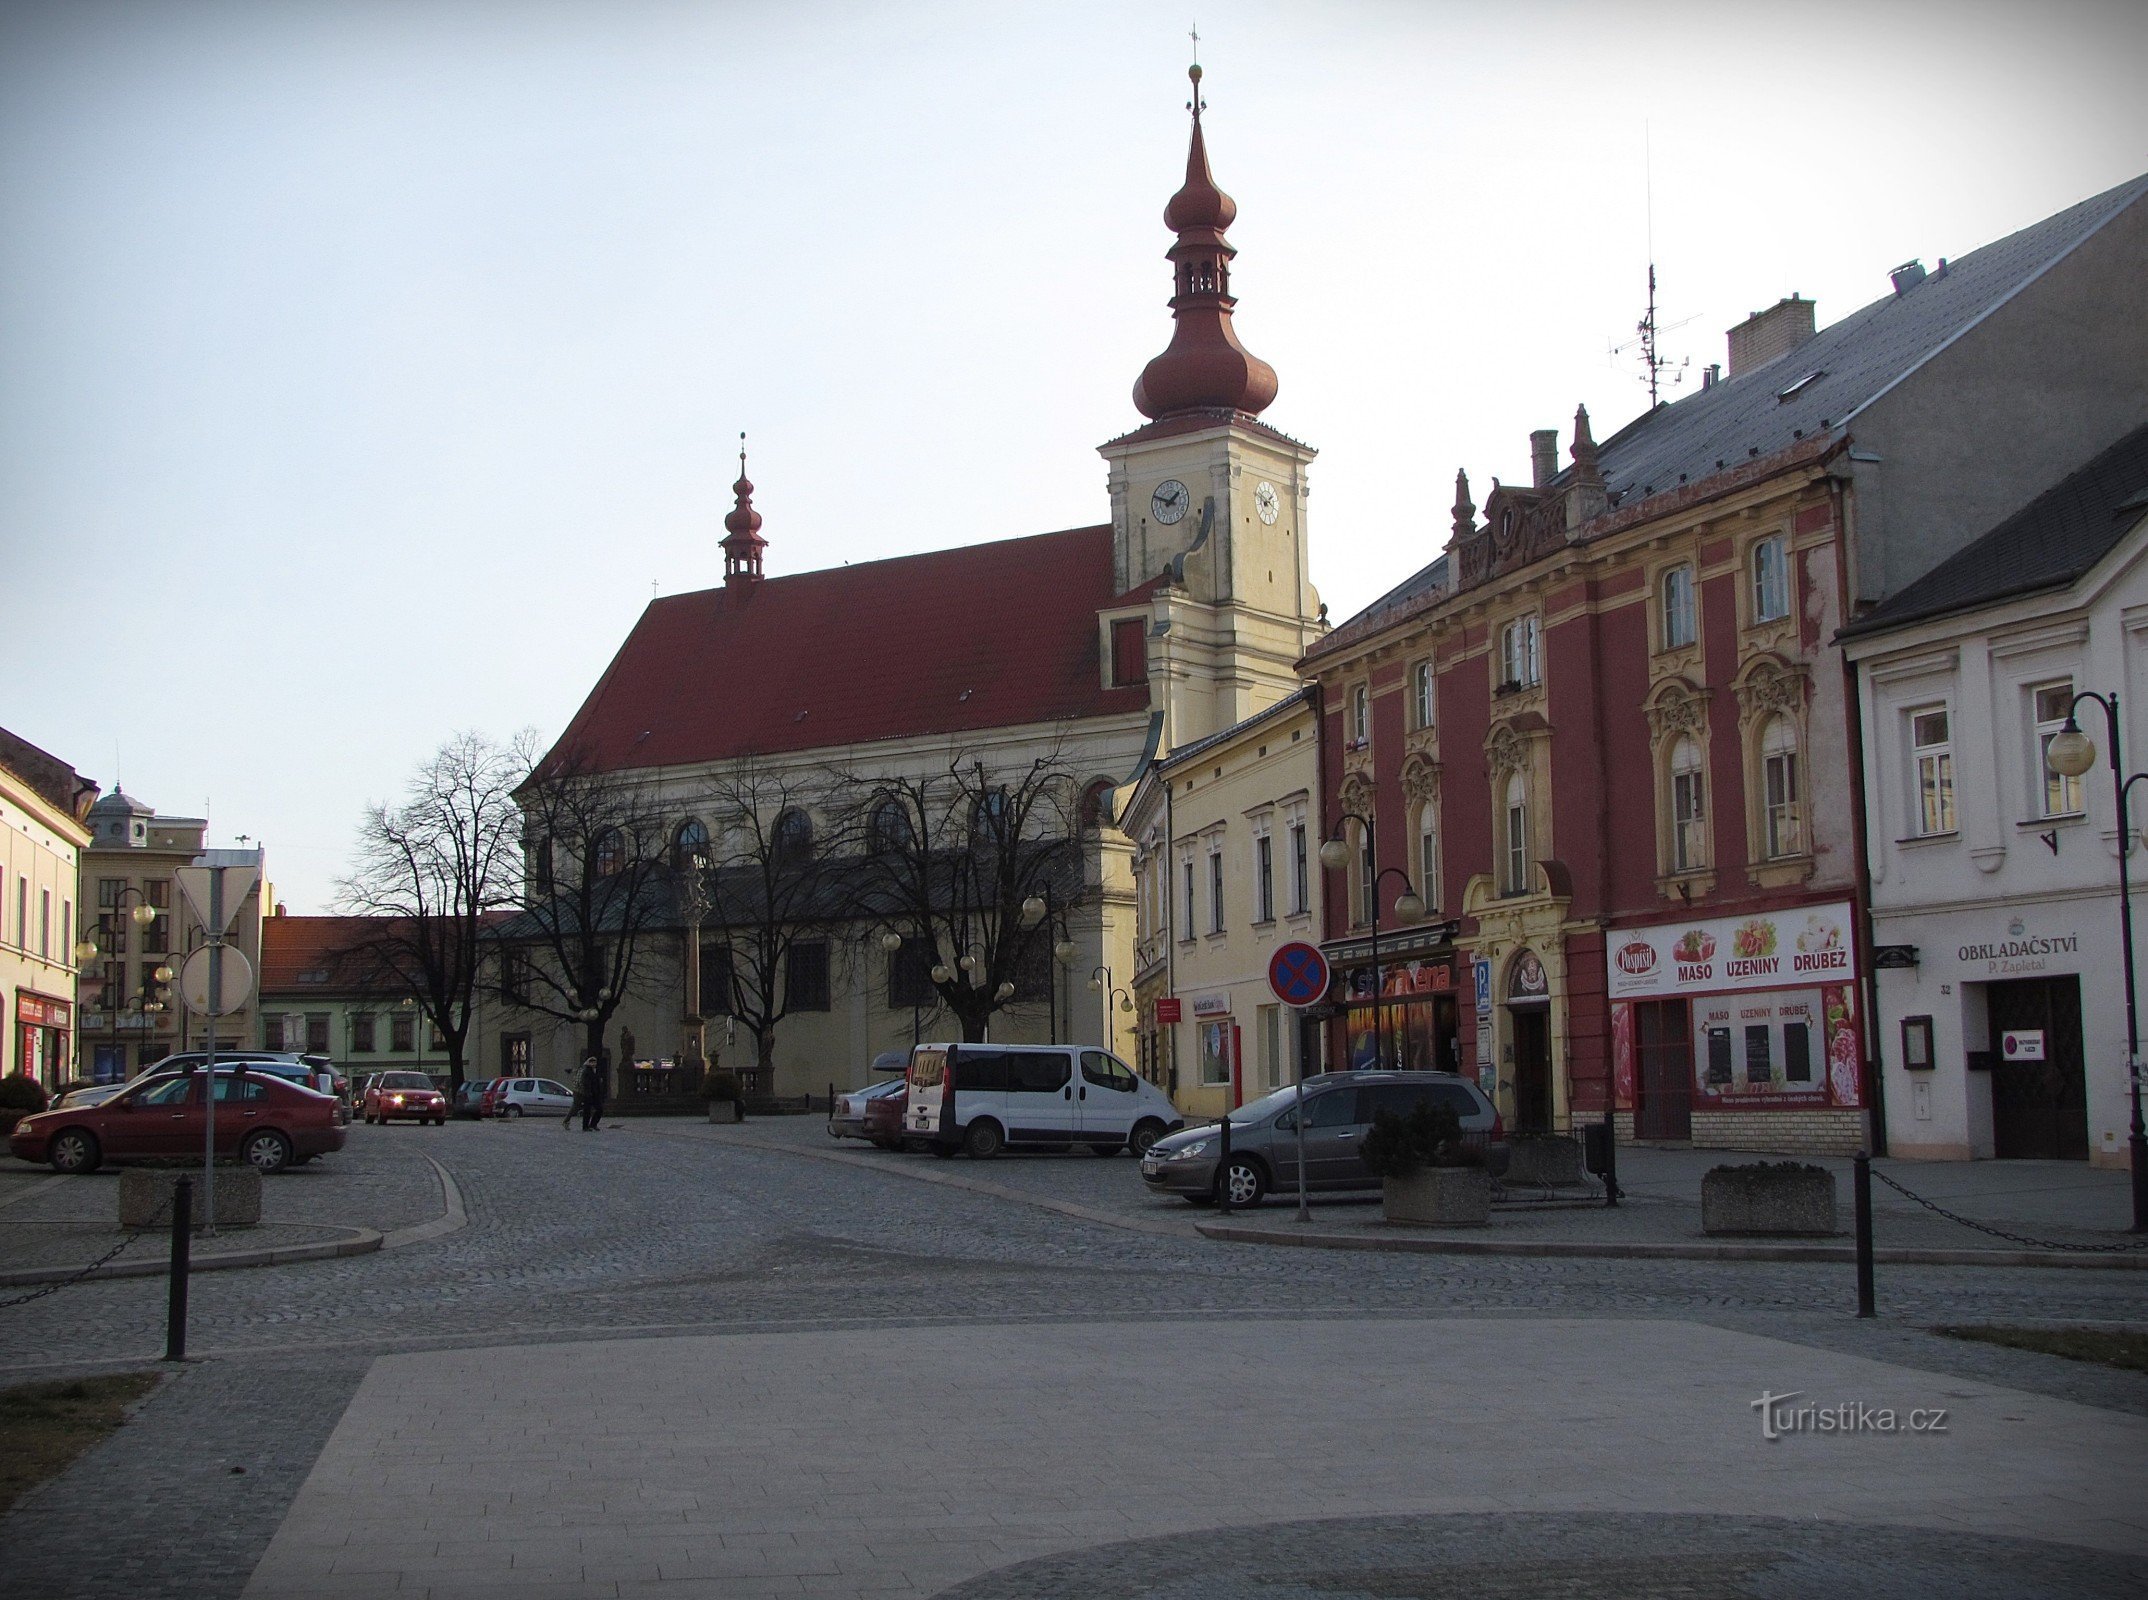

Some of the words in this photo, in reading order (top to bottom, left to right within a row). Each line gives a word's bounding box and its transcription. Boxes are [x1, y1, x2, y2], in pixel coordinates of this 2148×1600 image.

[1958, 932, 2078, 961] OBKLADAČSTVÍ
[1621, 946, 1653, 974] Pospíšil
[1678, 964, 1712, 982] MASO
[1726, 957, 1780, 977] UZENINY
[1988, 960, 1999, 974] P.
[2001, 958, 2046, 974] Zapletal
[1940, 984, 1951, 995] 32
[1708, 1011, 1730, 1021] MASO
[1740, 1007, 1771, 1019] UZENINY
